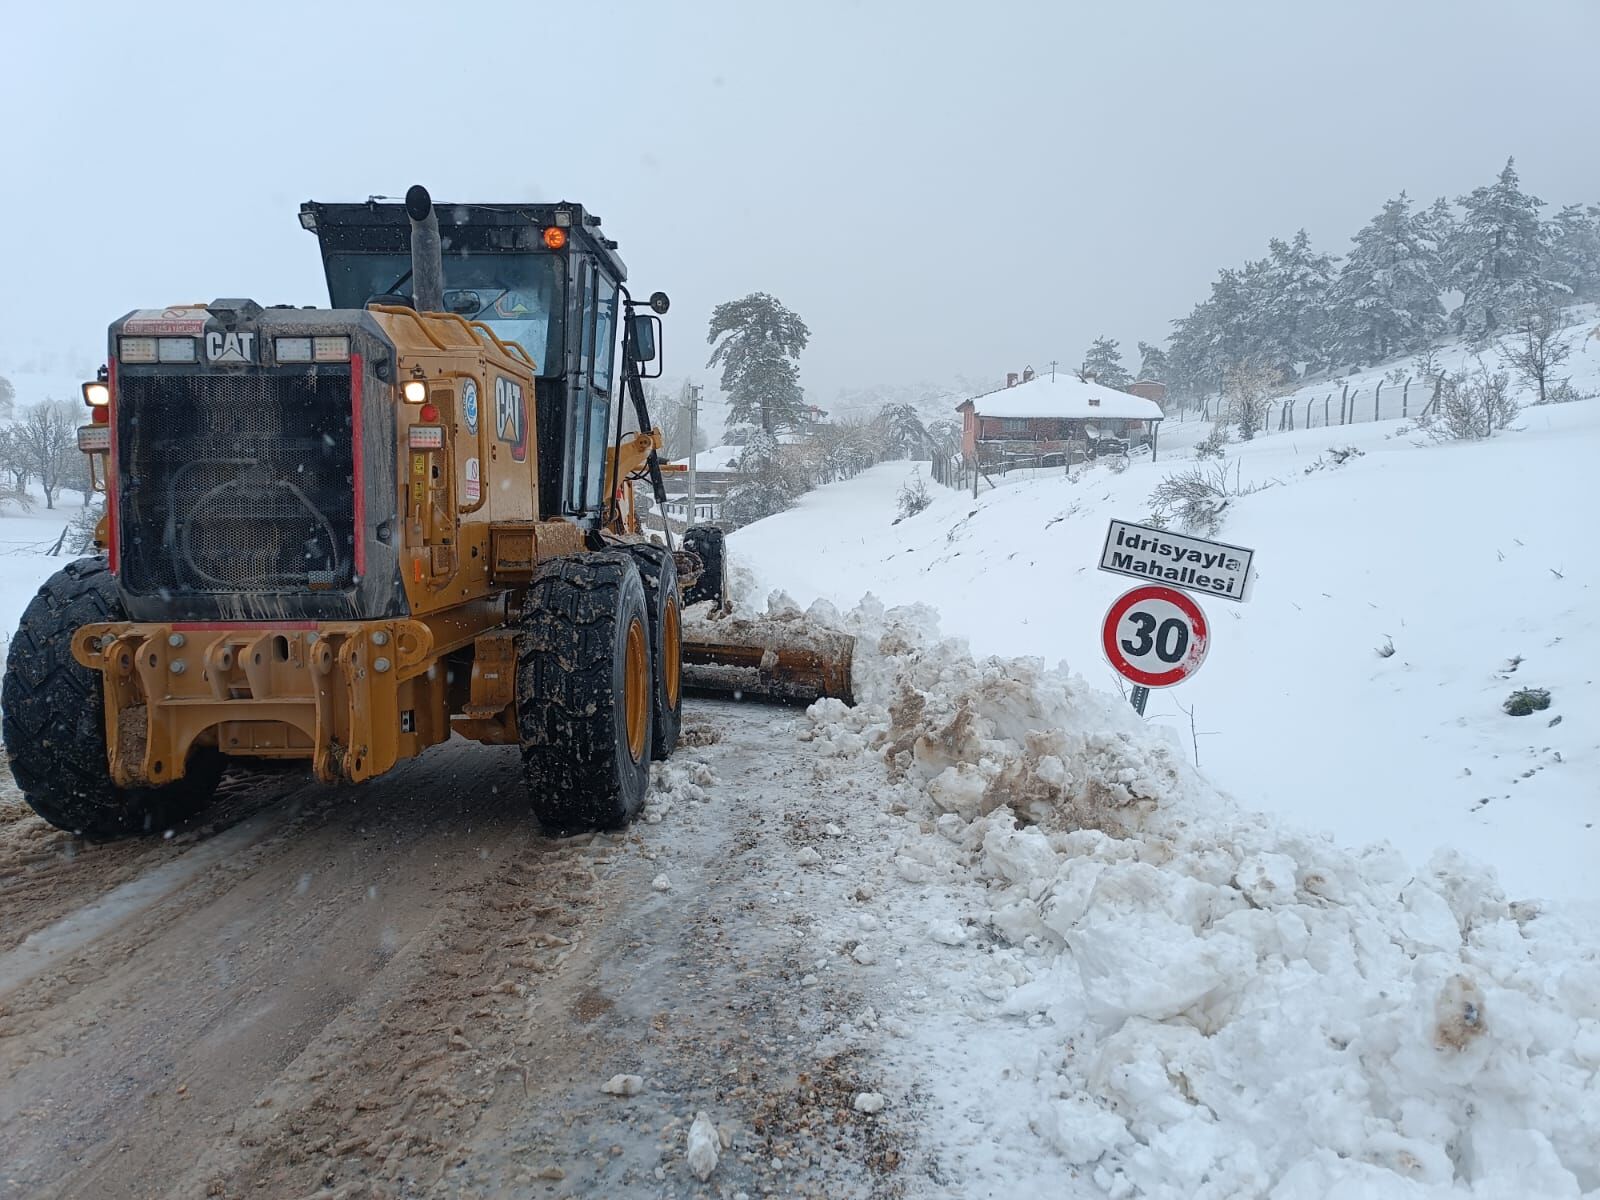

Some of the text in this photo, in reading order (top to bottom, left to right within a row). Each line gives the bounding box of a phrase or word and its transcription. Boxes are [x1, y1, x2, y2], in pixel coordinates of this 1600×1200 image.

[206, 331, 255, 361] CAT
[496, 377, 521, 441] CAT
[1116, 527, 1240, 572] İdrisyayla
[1111, 552, 1235, 593] Mahallesi
[1121, 611, 1189, 663] 30
